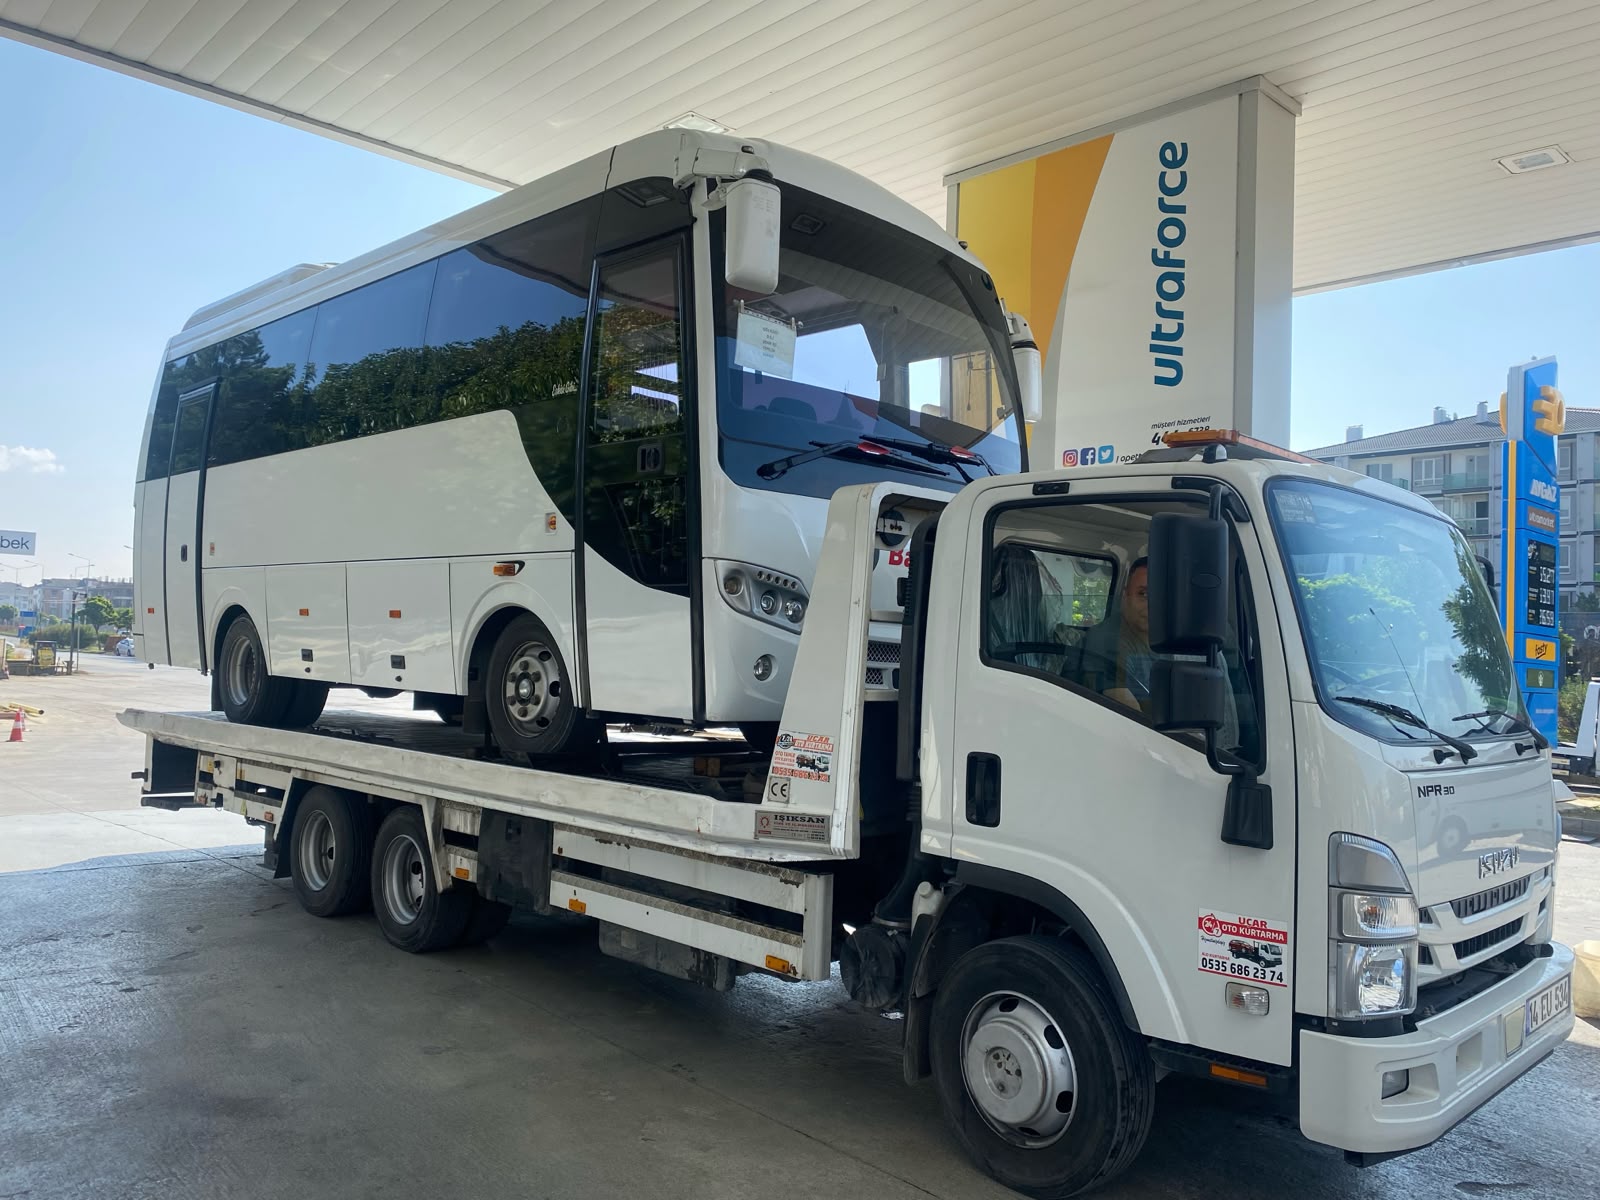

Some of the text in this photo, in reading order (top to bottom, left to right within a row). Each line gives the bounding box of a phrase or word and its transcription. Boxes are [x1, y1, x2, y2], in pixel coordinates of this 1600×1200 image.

[1149, 141, 1188, 387] ultraforce
[1, 535, 29, 550] bek
[1417, 784, 1455, 798] NPR 30
[1479, 846, 1520, 879] ISUZU
[1221, 924, 1238, 933] OTO
[1240, 926, 1284, 941] KURTARMA
[1201, 957, 1284, 983] 0535 686 23 74
